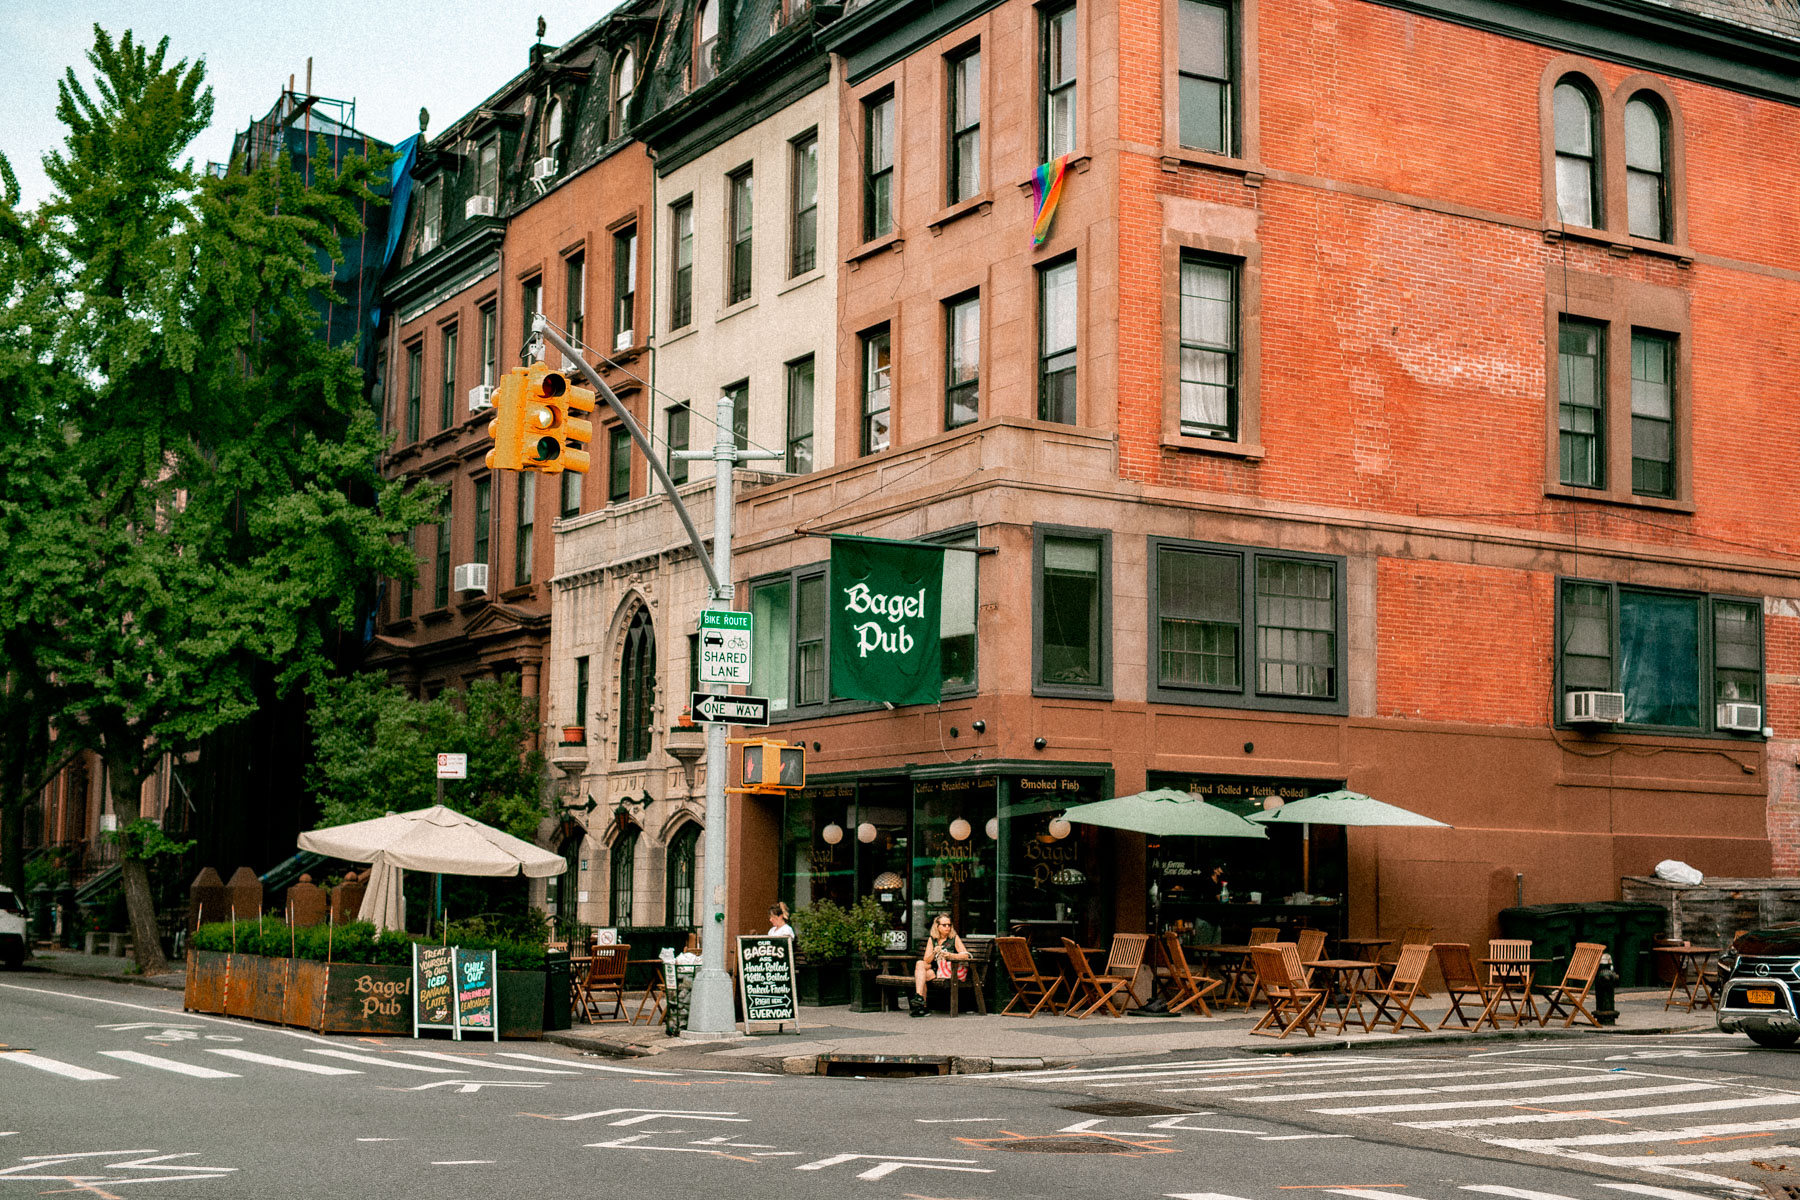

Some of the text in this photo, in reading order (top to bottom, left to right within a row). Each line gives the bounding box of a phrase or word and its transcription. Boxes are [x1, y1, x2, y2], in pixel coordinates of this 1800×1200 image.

[844, 583, 926, 623] Bagel
[705, 615, 747, 627] BIKE ROUTE
[854, 622, 914, 658] Pub
[704, 651, 747, 664] SHARED
[711, 665, 739, 677] LANE
[704, 702, 759, 716] ONE WAY
[916, 783, 934, 793] Coffee
[1021, 778, 1080, 792] Smoked Fish
[1190, 783, 1305, 799] Hand Rolled Kettle Boiled
[1023, 839, 1078, 865] Bagel
[423, 948, 446, 959] TREAT
[743, 946, 784, 960] BAGELS
[419, 957, 451, 970] YOURSELF
[463, 961, 485, 974] CHILL
[744, 961, 788, 972] Hand Rolled
[424, 966, 449, 979] TO OUR
[466, 971, 484, 983] OUT
[766, 972, 790, 982] Boiled
[354, 975, 410, 998] Bagel
[427, 974, 448, 989] ICED
[420, 986, 450, 1003] BANANA
[747, 984, 770, 994] Baked
[360, 996, 401, 1018] Pub
[426, 996, 447, 1011] LATTE
[460, 997, 491, 1013] LEMONADE
[754, 998, 771, 1006] RIGHT
[750, 1009, 792, 1018] EVERYDAY
